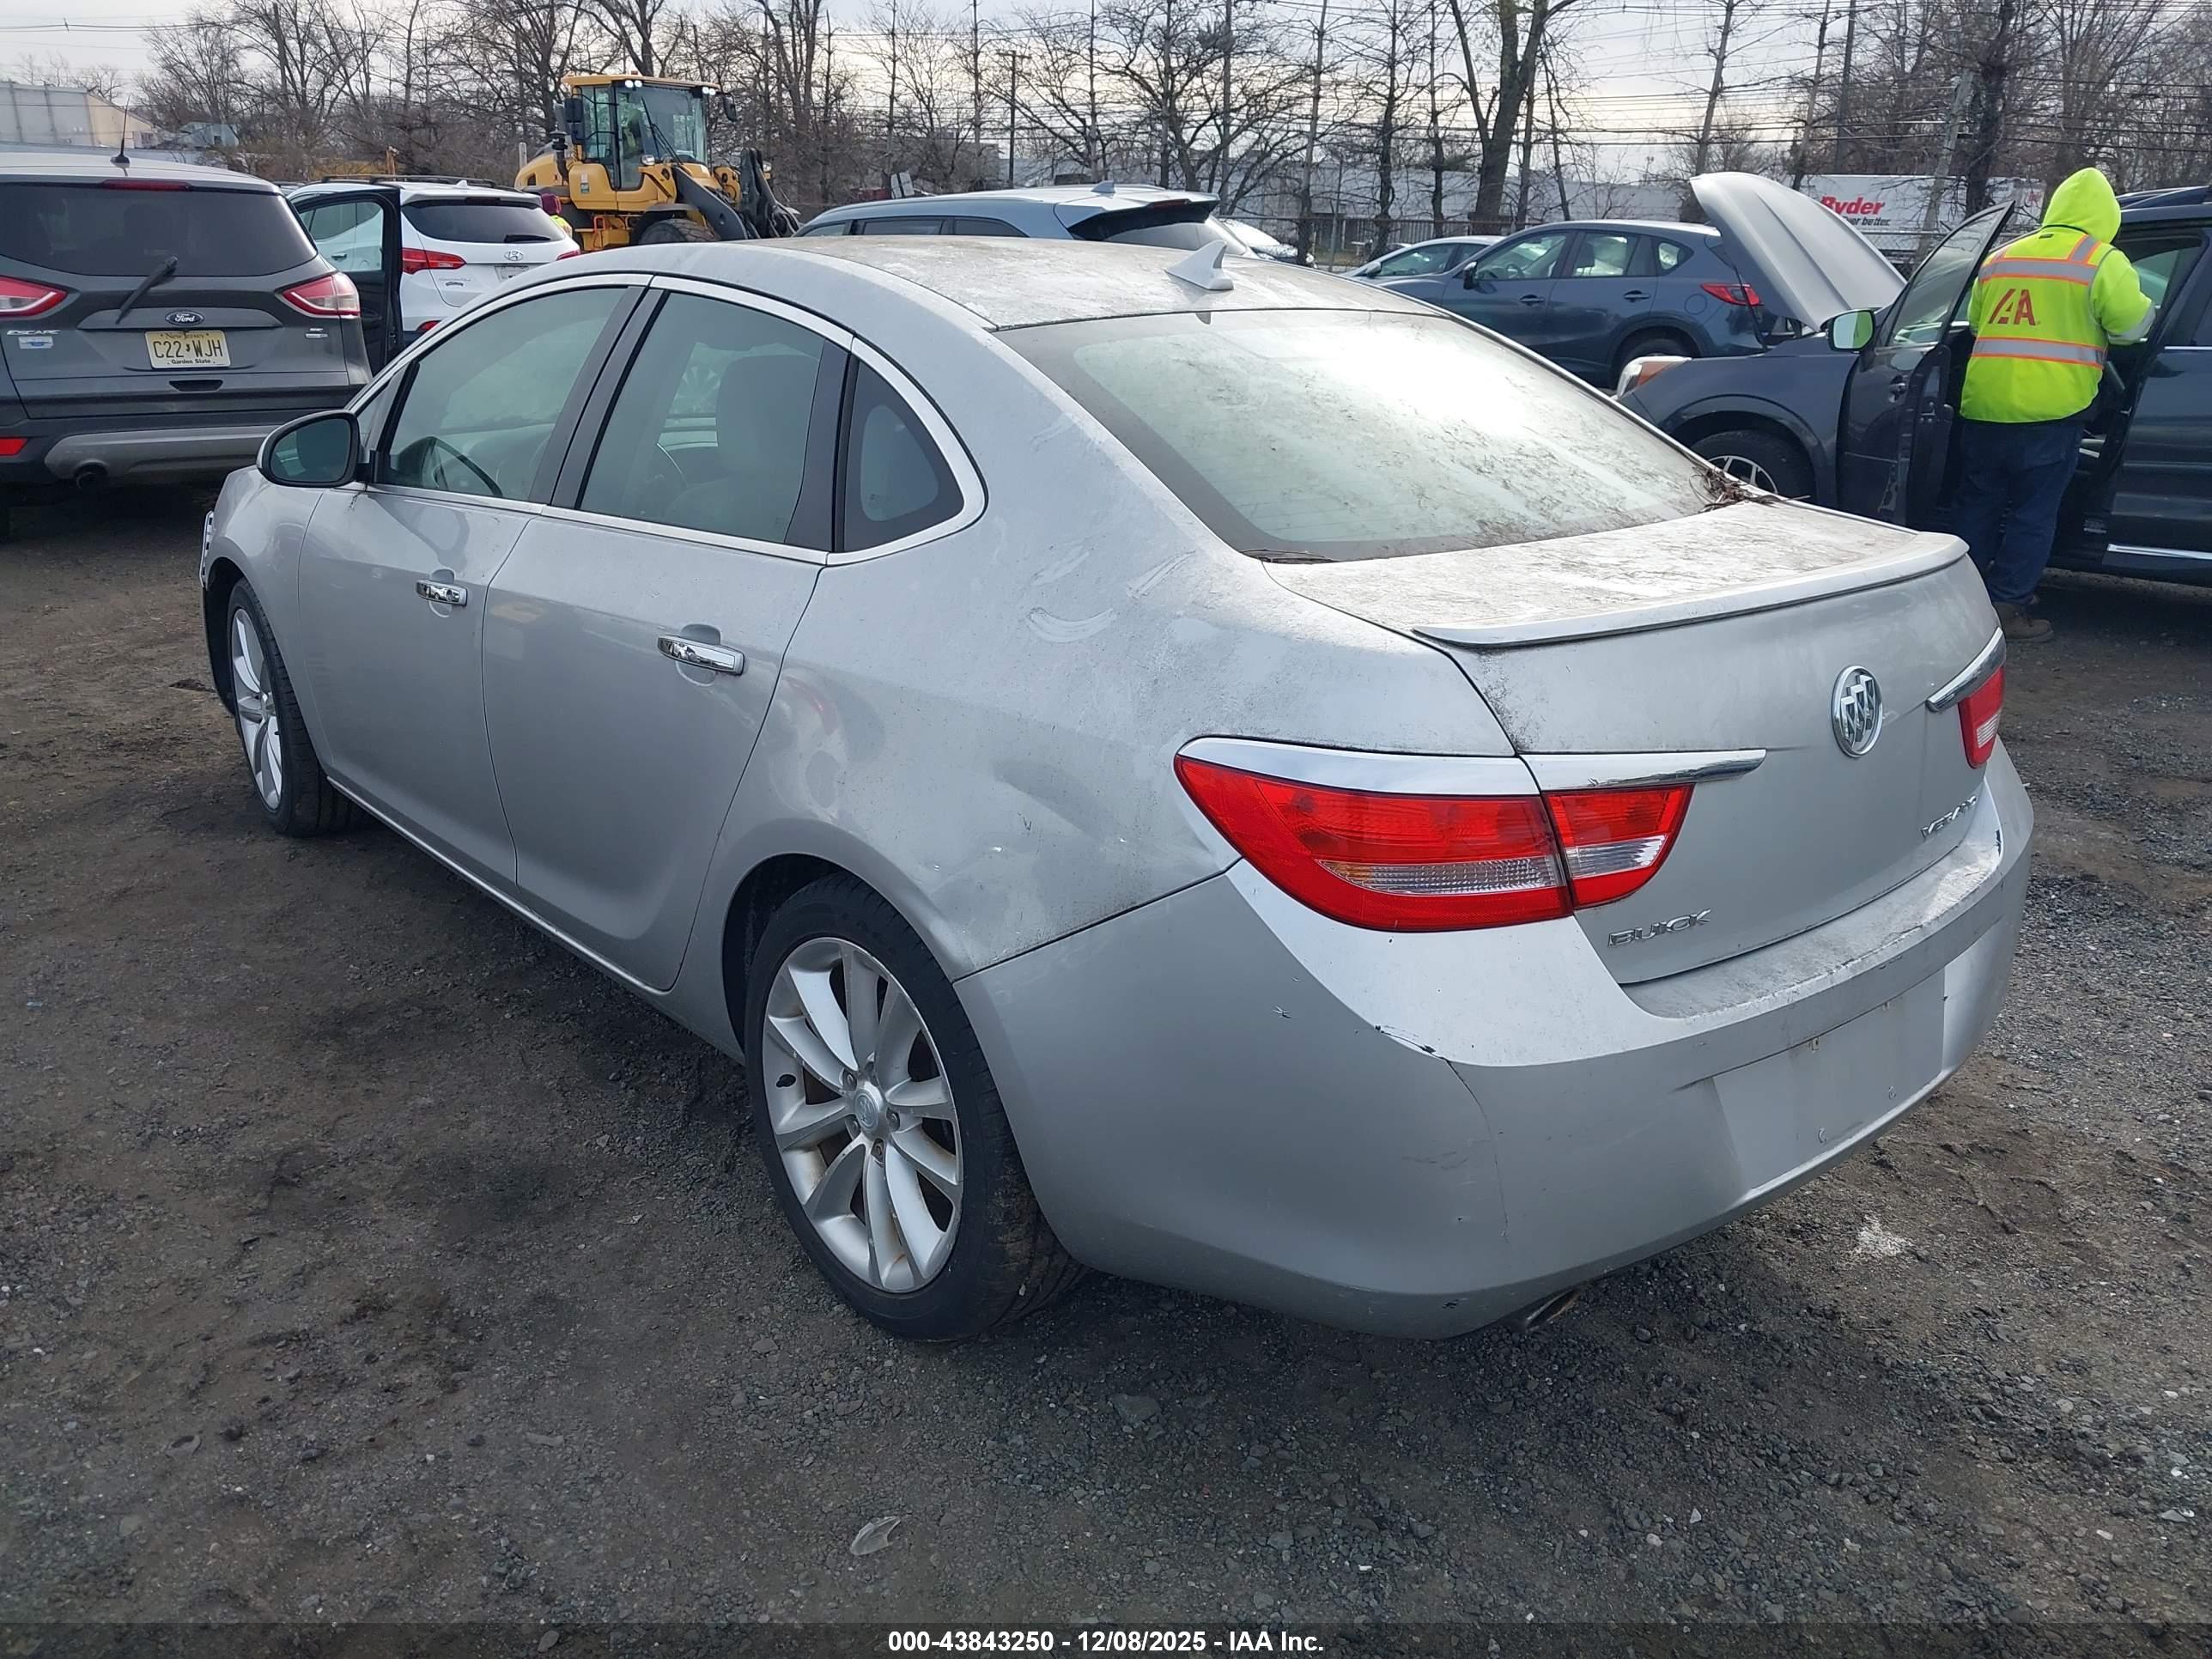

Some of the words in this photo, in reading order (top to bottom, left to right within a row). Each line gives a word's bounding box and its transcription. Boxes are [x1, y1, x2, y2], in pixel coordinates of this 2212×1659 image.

[1820, 196, 1885, 215] Ryder
[174, 313, 195, 323] Ford
[153, 340, 185, 358] C22
[191, 339, 223, 358] WJH
[1607, 908, 1711, 947] BUICK
